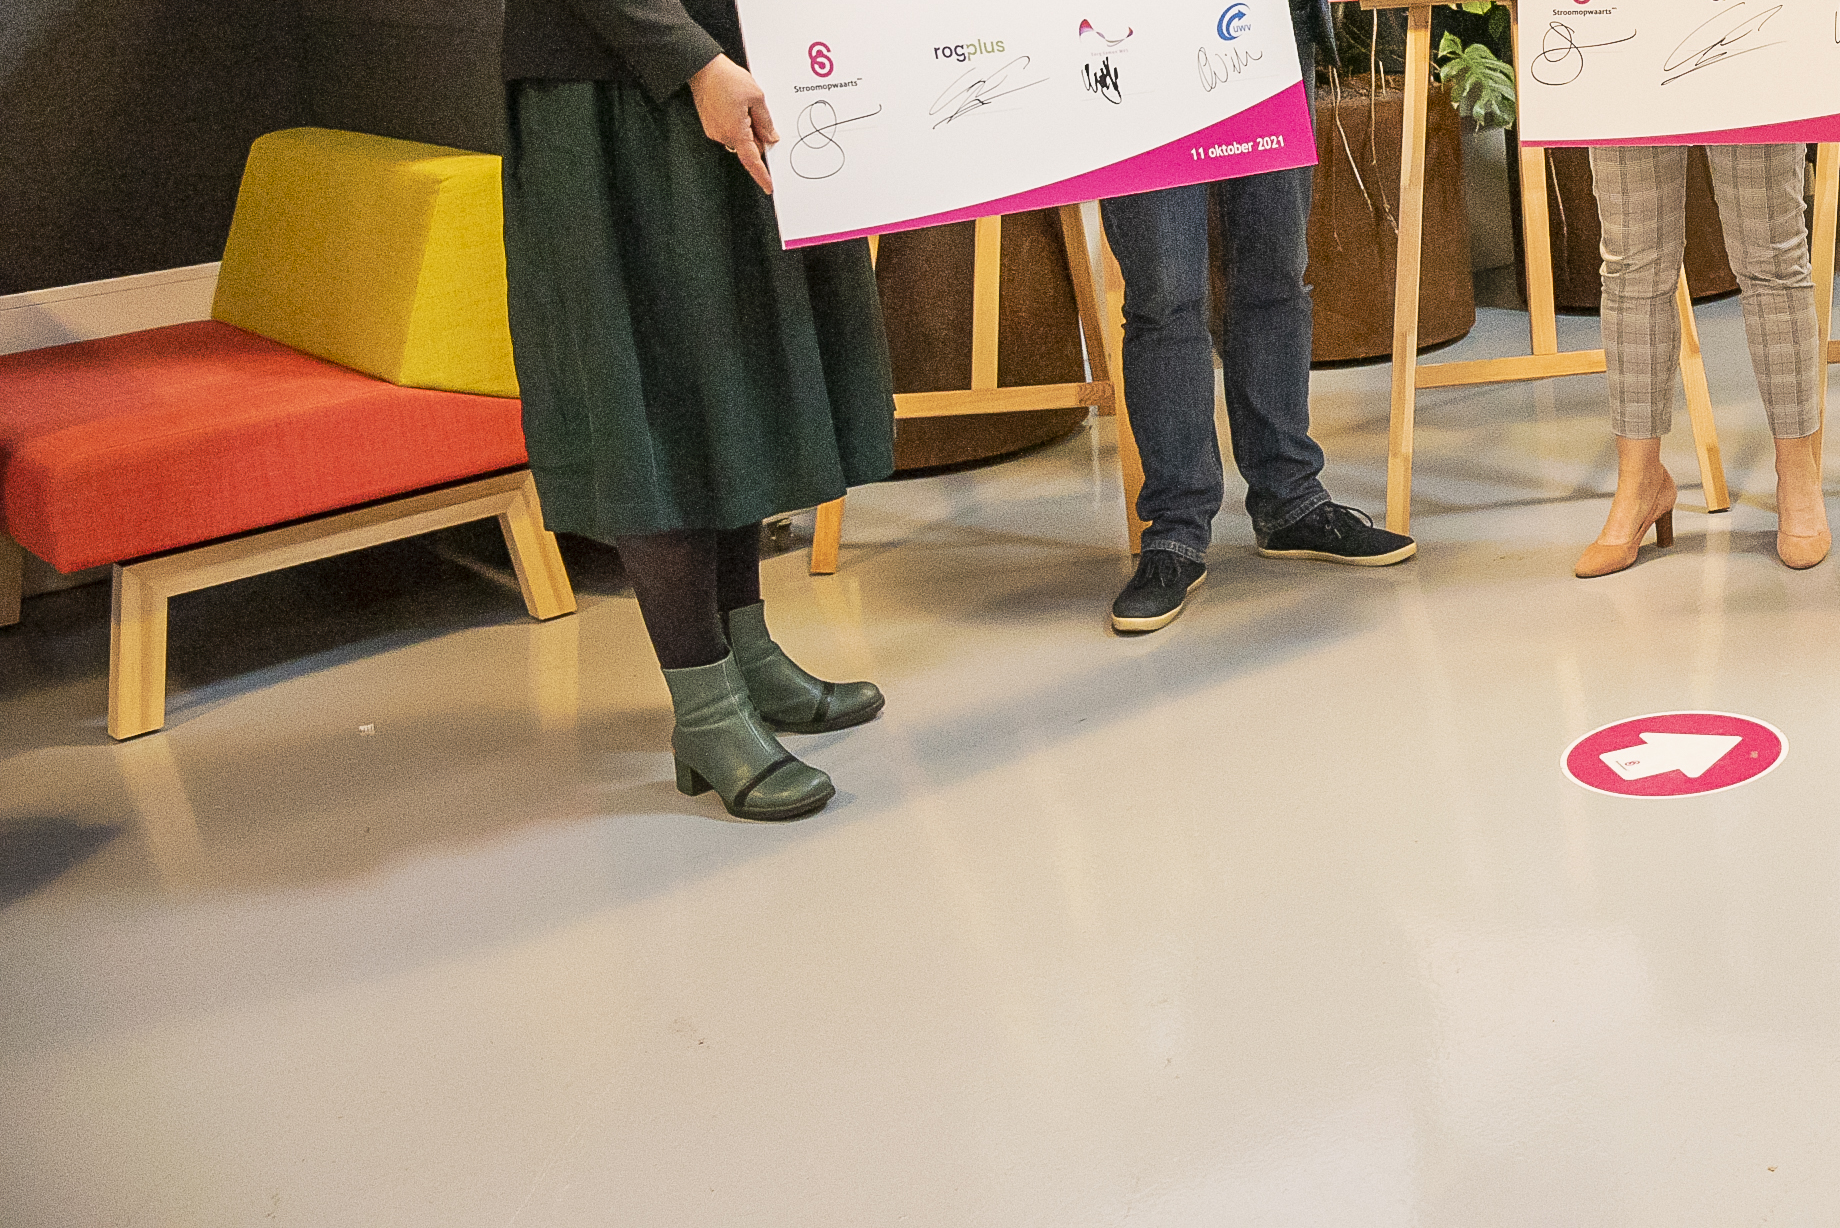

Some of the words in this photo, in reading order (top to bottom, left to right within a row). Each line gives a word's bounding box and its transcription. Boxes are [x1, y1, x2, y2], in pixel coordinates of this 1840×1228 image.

[1552, 8, 1612, 17] Stroomopwaarts
[934, 39, 1004, 62] rogplus
[793, 79, 858, 94] Stroomopwaarts
[1191, 147, 1204, 160] 11
[1209, 142, 1253, 157] oktober
[1257, 135, 1284, 150] 2021
